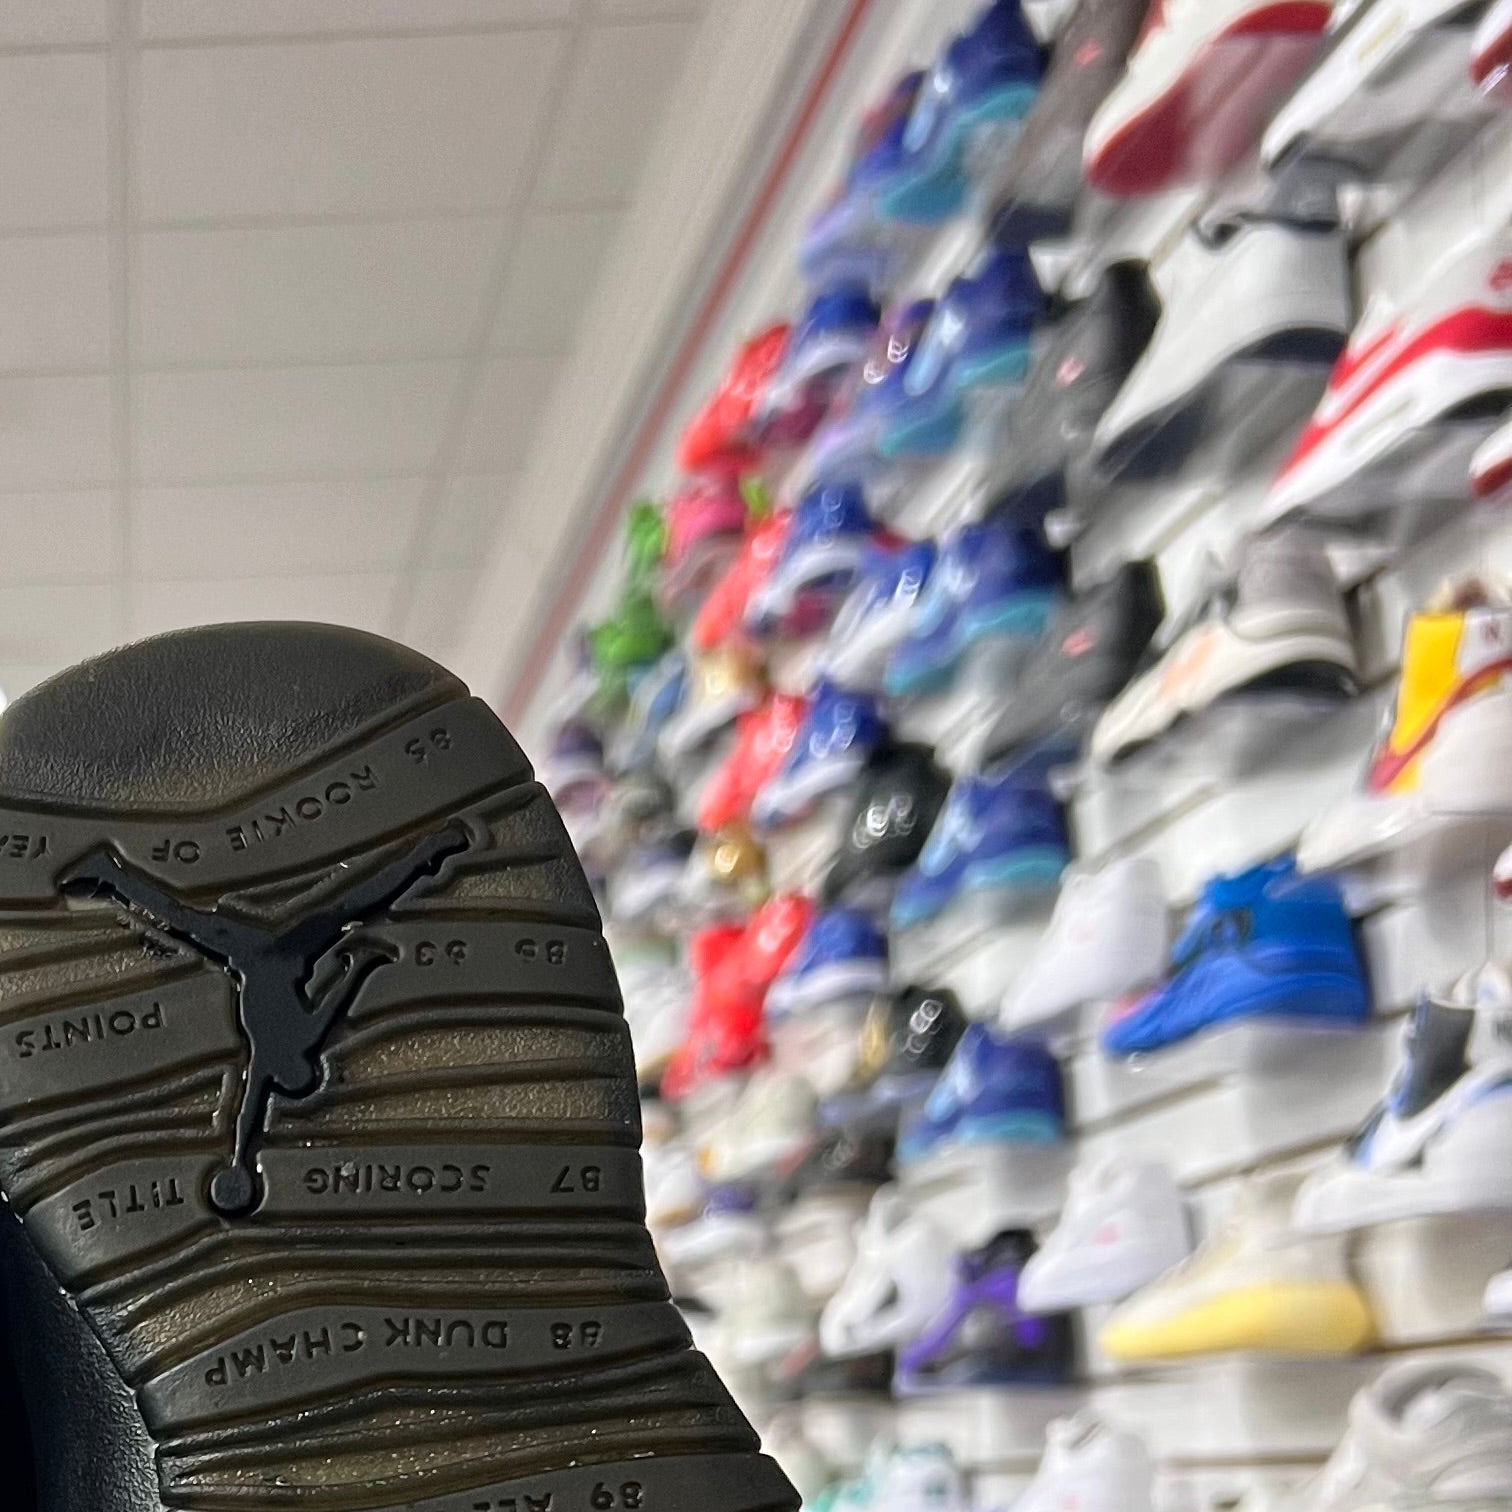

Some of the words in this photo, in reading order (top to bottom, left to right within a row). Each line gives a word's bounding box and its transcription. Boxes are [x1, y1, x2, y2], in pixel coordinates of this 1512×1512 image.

[405, 726, 454, 766] 85
[225, 764, 379, 853] ROOKIE
[151, 838, 201, 864] OF
[413, 939, 468, 967] 63
[514, 939, 568, 966] 86
[16, 1003, 164, 1059] POINTS
[305, 1164, 492, 1194] SCORING
[551, 1165, 602, 1194] 87
[71, 1176, 184, 1231] TITLE
[386, 1318, 508, 1349] DUNK
[550, 1321, 604, 1349] 88
[204, 1323, 366, 1388] CHAMP
[591, 1481, 644, 1511] 89
